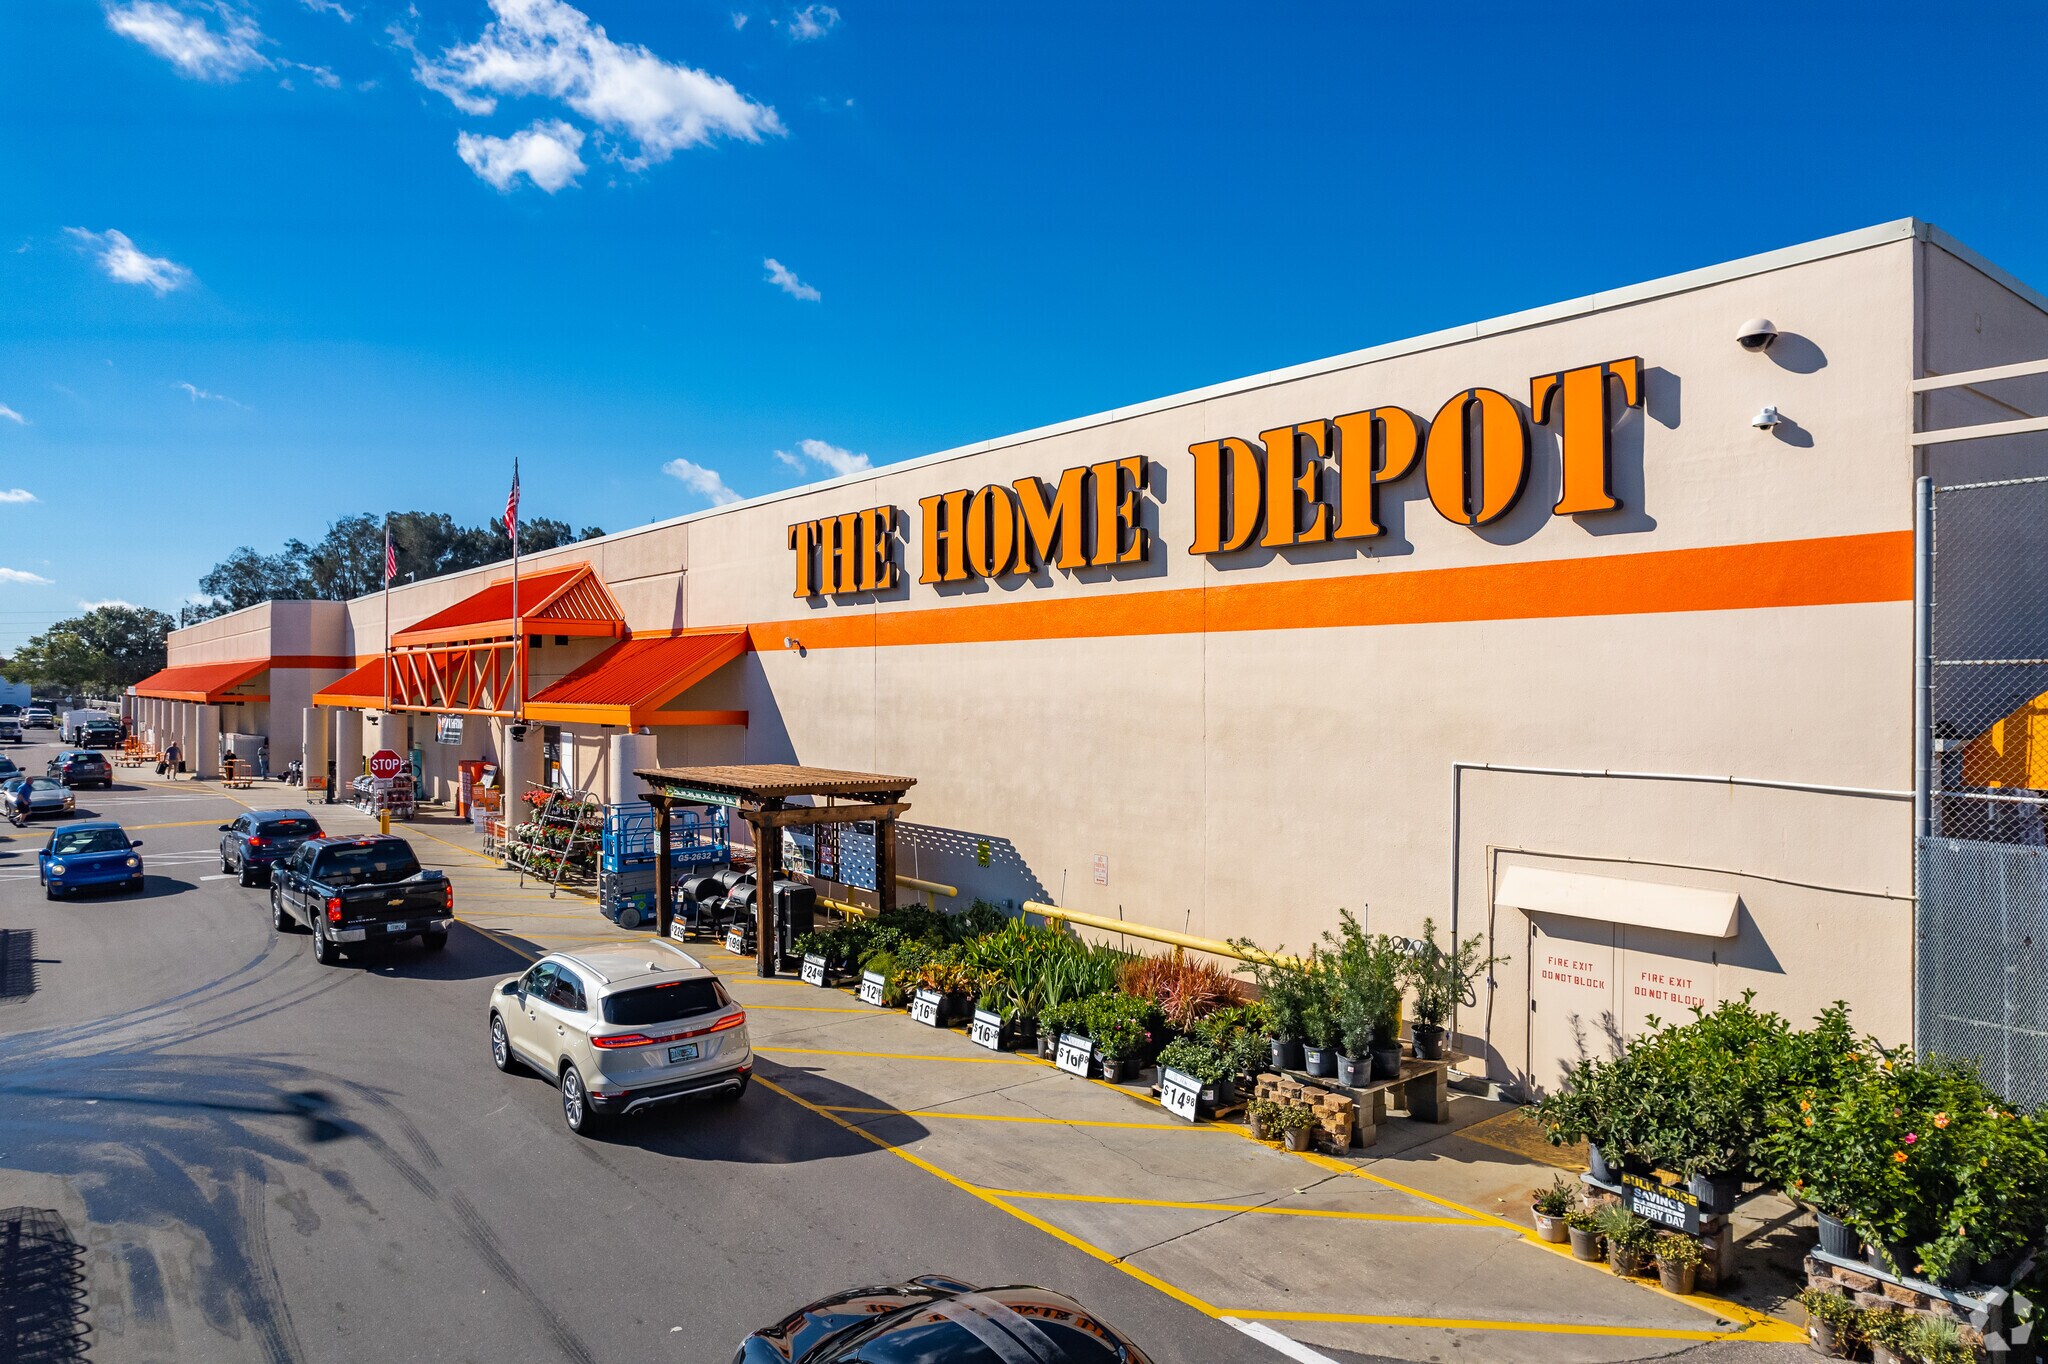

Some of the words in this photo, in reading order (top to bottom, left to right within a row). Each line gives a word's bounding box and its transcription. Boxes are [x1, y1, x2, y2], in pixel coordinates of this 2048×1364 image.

[787, 505, 898, 598] THE
[918, 455, 1149, 585] HOME
[1188, 356, 1646, 555] DEPOT
[371, 759, 400, 771] STOP
[677, 852, 712, 863] GS-2632
[1548, 956, 1569, 968] FIRE
[1572, 961, 1594, 972] EXIT
[1541, 969, 1553, 980] DO
[1554, 972, 1572, 983] NOT
[1573, 976, 1605, 989] BLOCK
[1641, 972, 1665, 984] FIRE
[1668, 977, 1692, 989] EXIT
[1634, 986, 1647, 997] DO
[1648, 989, 1669, 1001] NOT
[1670, 993, 1705, 1008] BLOCK
[1622, 1174, 1656, 1193] BULK
[1658, 1185, 1698, 1207] PRICE
[1633, 1187, 1686, 1213] SAVINGS
[1633, 1202, 1664, 1221] EVERY
[1665, 1213, 1686, 1229] DAY
